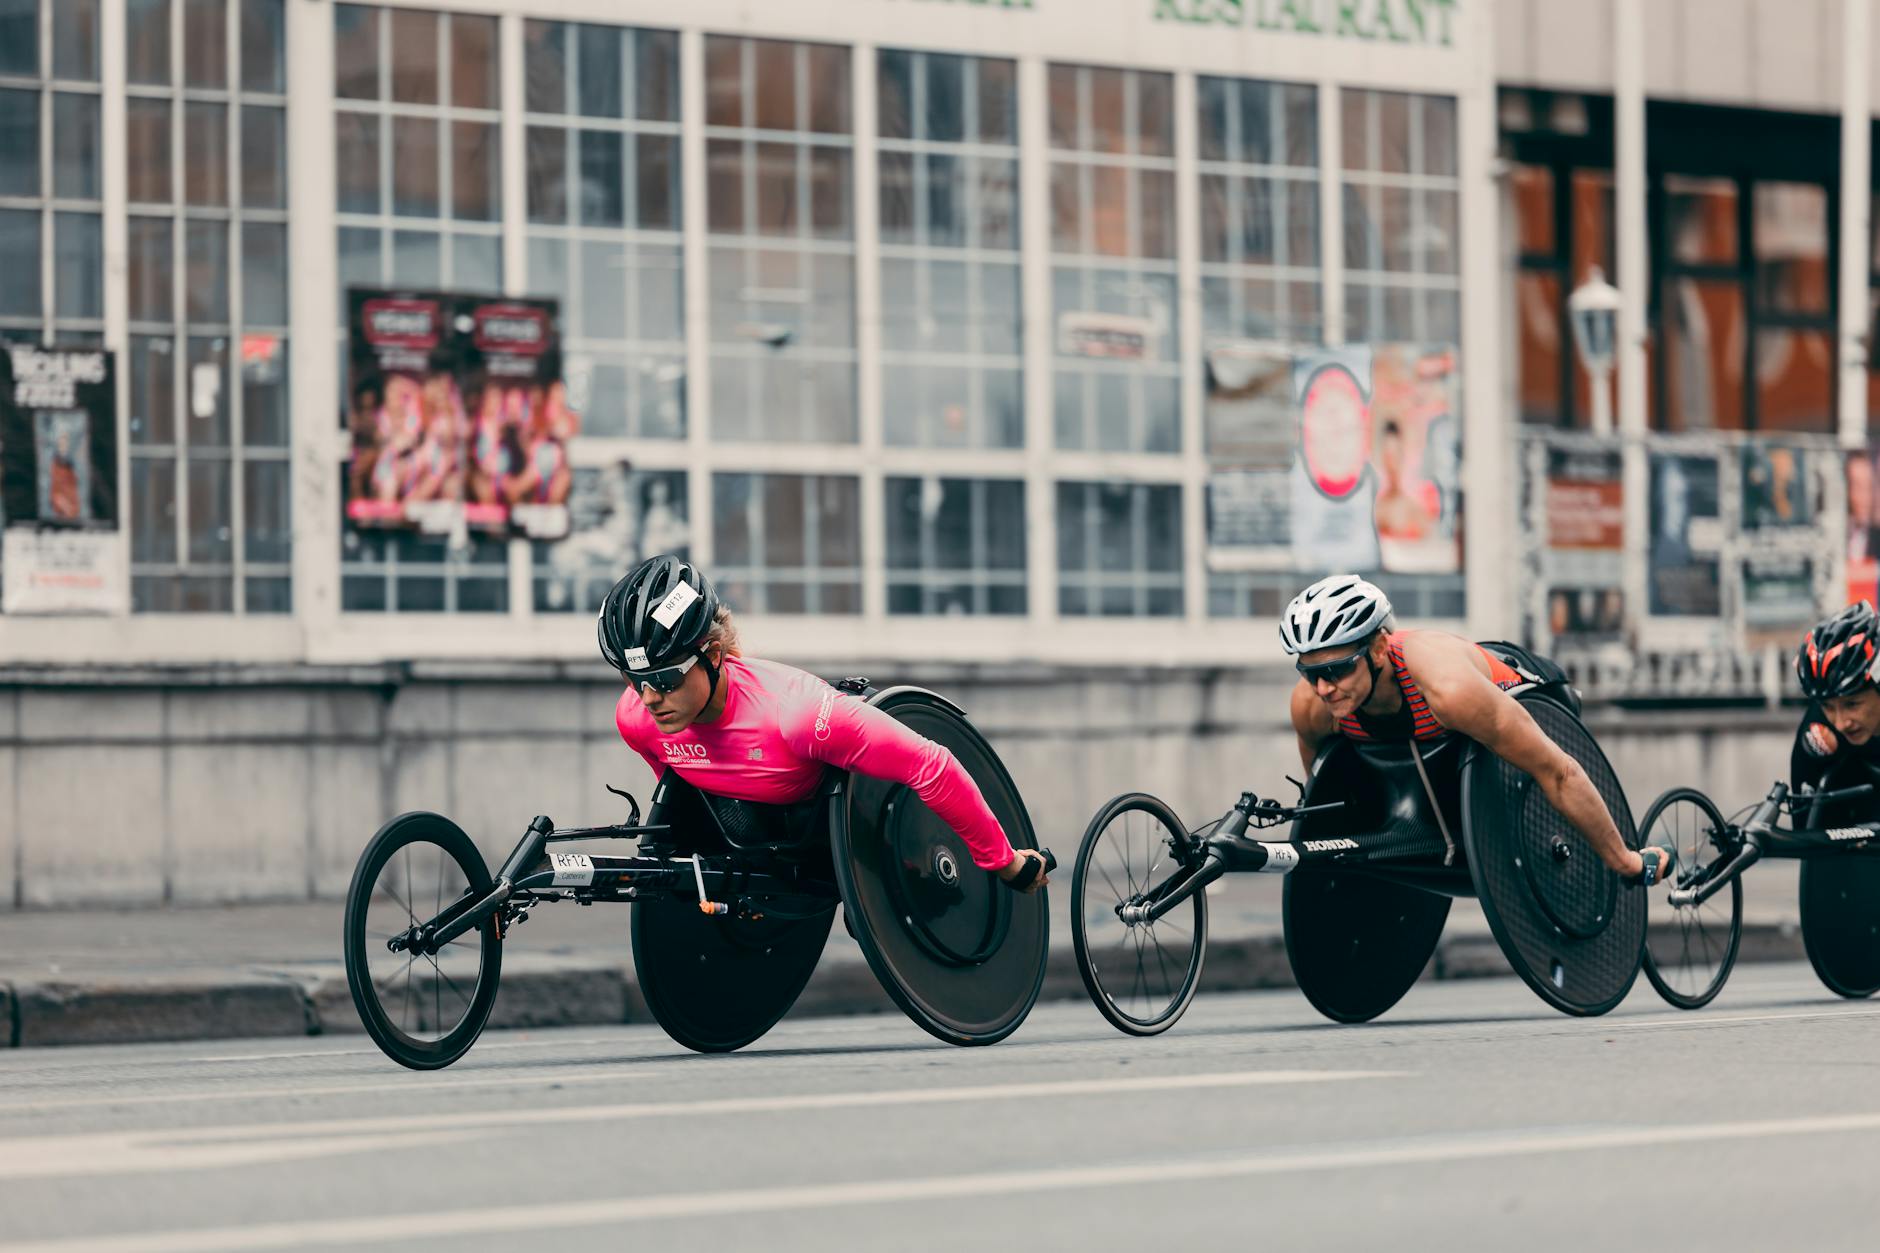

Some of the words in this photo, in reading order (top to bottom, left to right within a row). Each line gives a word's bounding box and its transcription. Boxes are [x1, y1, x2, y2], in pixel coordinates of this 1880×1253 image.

[665, 592, 683, 611] RF12
[627, 654, 647, 664] RF12
[663, 742, 706, 758] SALTO
[1825, 827, 1875, 840] HONDA
[1303, 838, 1359, 851] HONDA
[556, 854, 588, 867] RF12
